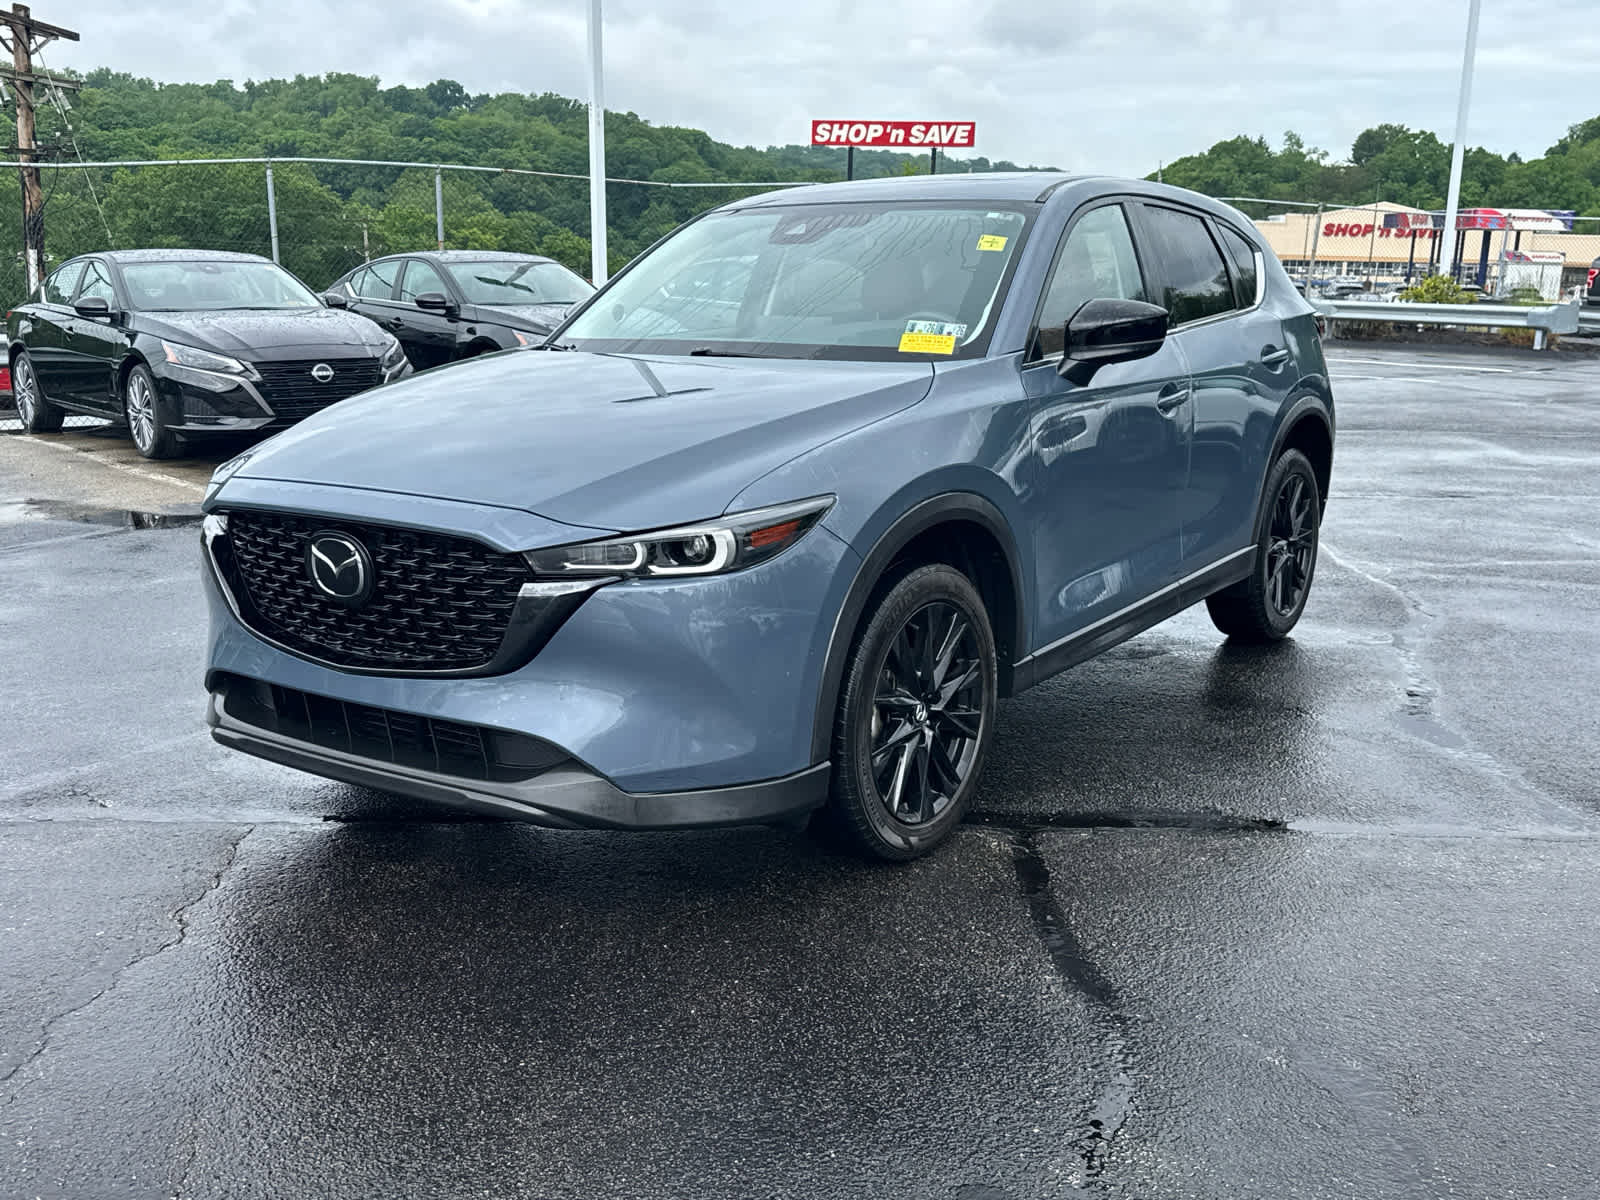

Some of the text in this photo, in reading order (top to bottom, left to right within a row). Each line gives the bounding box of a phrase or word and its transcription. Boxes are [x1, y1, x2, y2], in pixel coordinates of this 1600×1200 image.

[815, 123, 971, 144] SHOP 'n SAVE
[1323, 223, 1374, 237] SHOP
